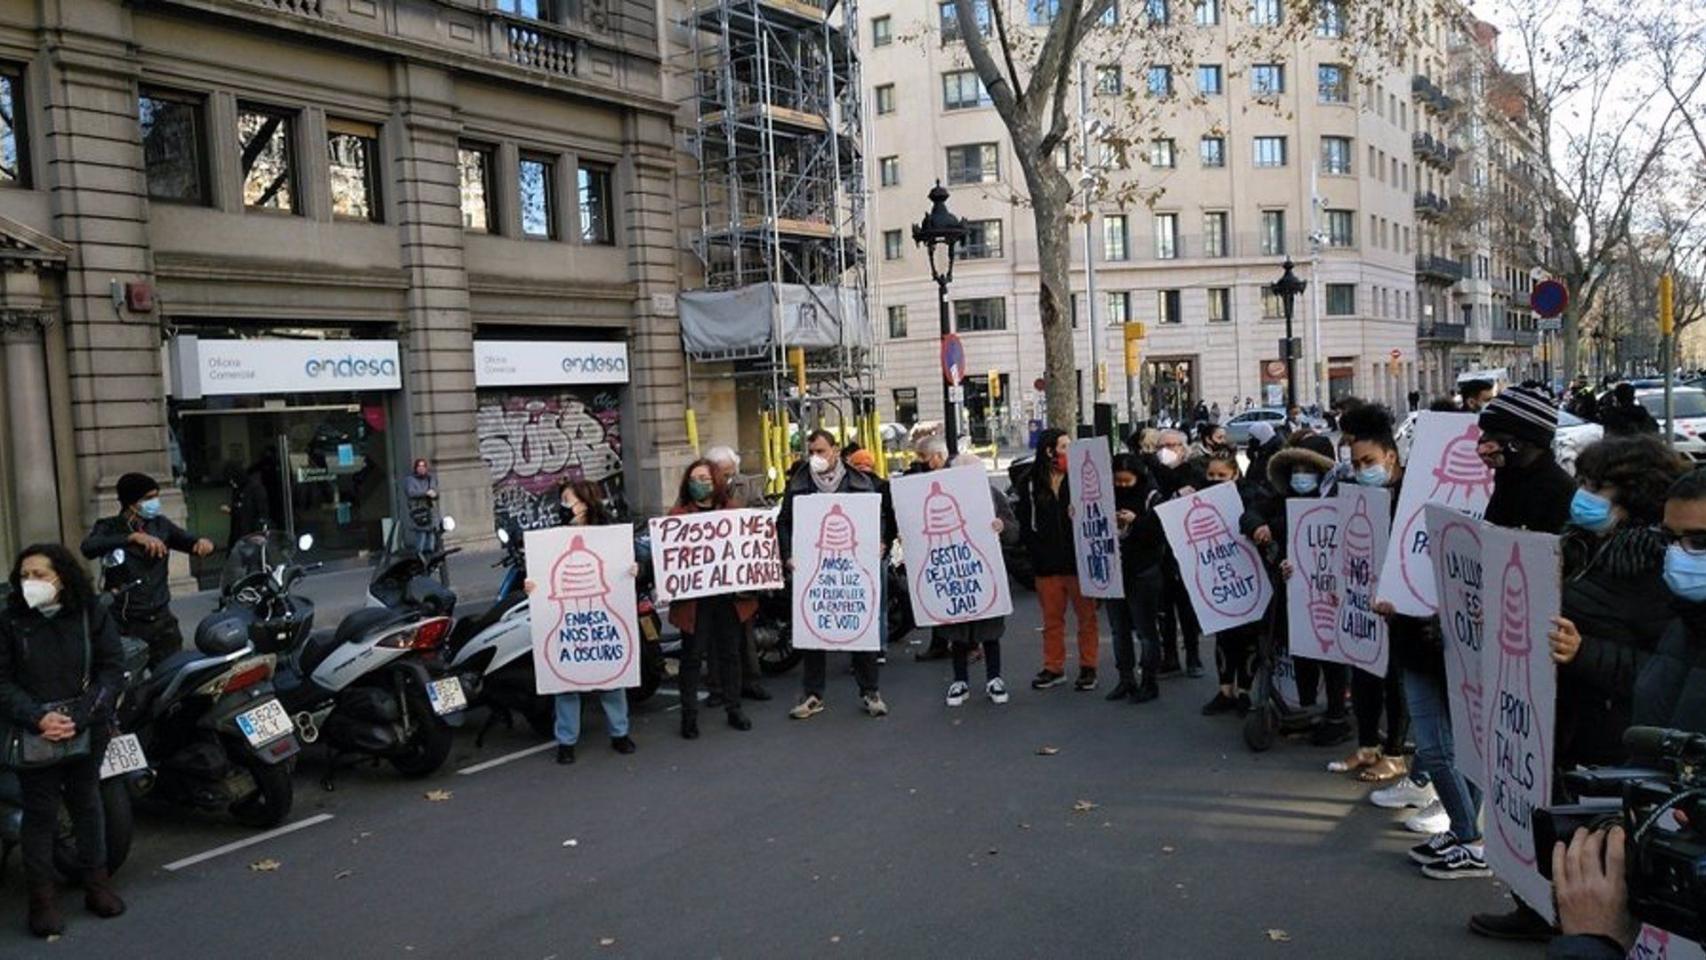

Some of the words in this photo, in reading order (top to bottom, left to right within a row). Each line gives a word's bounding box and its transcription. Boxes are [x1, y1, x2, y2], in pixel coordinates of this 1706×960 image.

[305, 357, 396, 377] endesa
[562, 354, 625, 373] endesa
[1087, 502, 1101, 519] LA
[660, 518, 732, 543] PASSO
[1083, 517, 1109, 538] LLUM
[1308, 524, 1338, 549] LUZ
[663, 545, 716, 571] FRED
[722, 541, 736, 561] A
[741, 540, 781, 560] CASA
[930, 540, 972, 566] GESTIÓ
[1318, 552, 1327, 571] O
[665, 570, 703, 598] QUE
[709, 564, 733, 588] AL
[818, 573, 836, 586] SIN
[841, 572, 860, 586] LUZ
[926, 568, 942, 584] DE
[956, 559, 983, 579] LLUM
[1350, 558, 1369, 586] NO
[808, 587, 821, 599] NO
[1211, 574, 1254, 604] SALUT
[565, 610, 609, 626] ENDESA
[818, 614, 832, 629] DE
[834, 614, 860, 631] VOTO
[560, 627, 589, 643] NOS
[591, 625, 620, 641] DEJA
[560, 647, 571, 663] A
[574, 644, 623, 662] OSCURAS
[1500, 690, 1530, 739] PROU
[1495, 729, 1534, 791] TALLS
